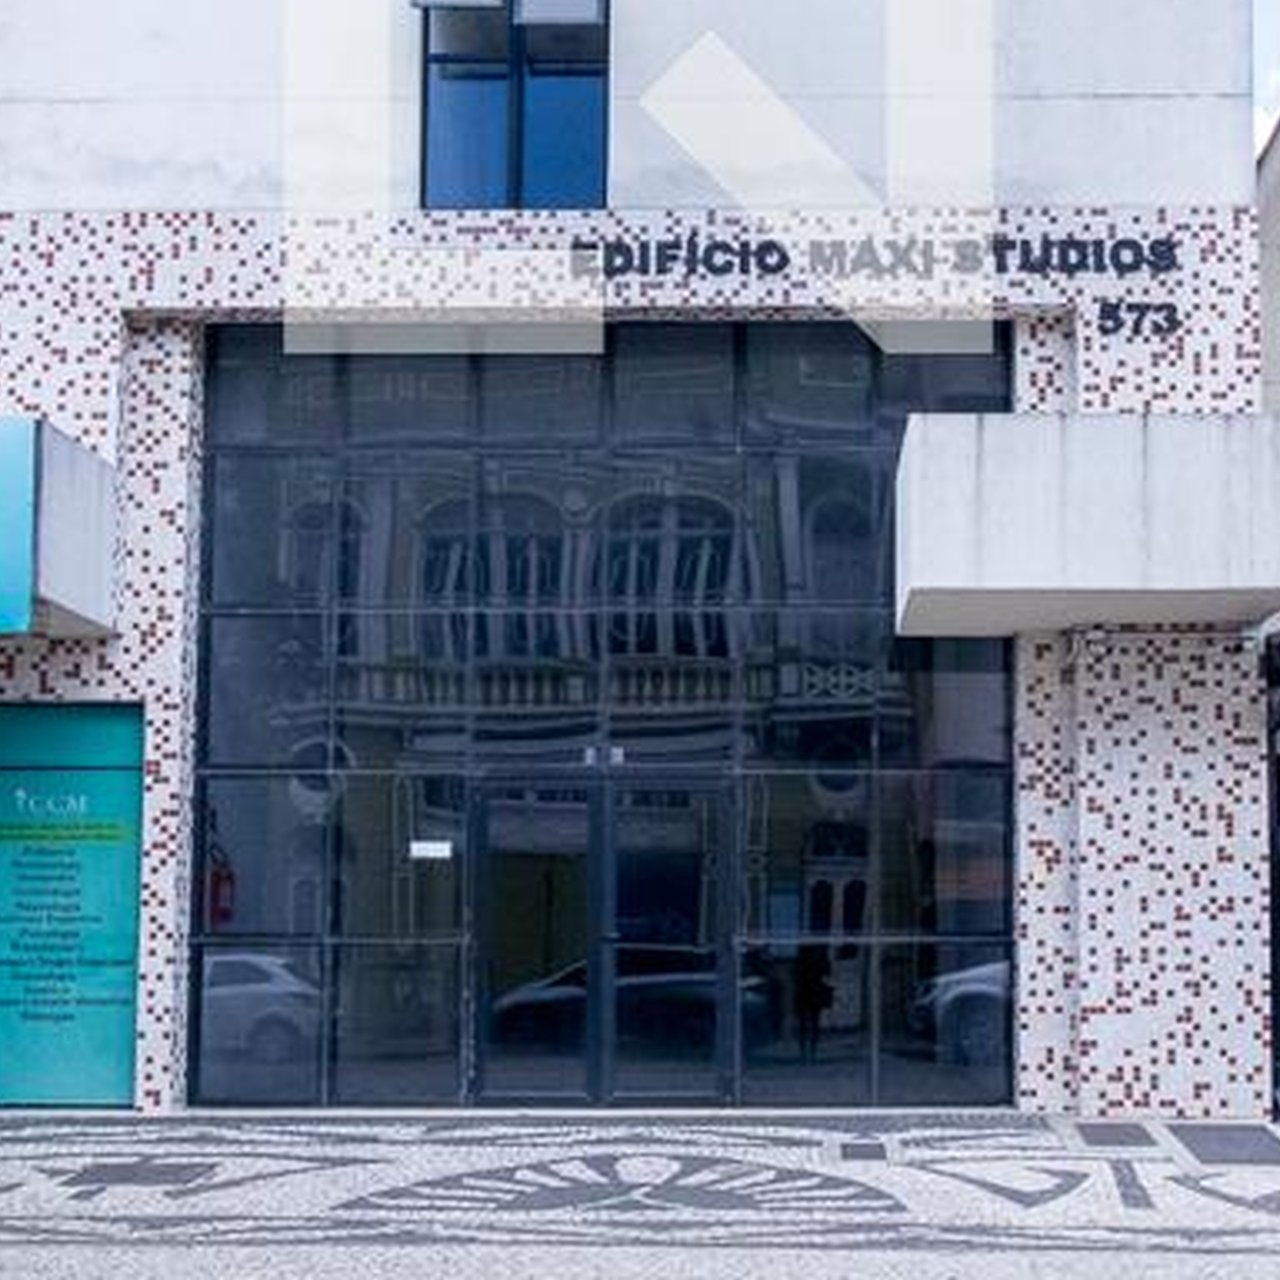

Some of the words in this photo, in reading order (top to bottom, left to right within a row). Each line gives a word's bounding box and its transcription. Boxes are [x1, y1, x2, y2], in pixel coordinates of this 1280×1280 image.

[572, 228, 790, 276] EDIFÍCIO
[809, 239, 934, 275] MAXI
[954, 237, 1179, 273] STUDIOS
[1098, 302, 1182, 335] 573
